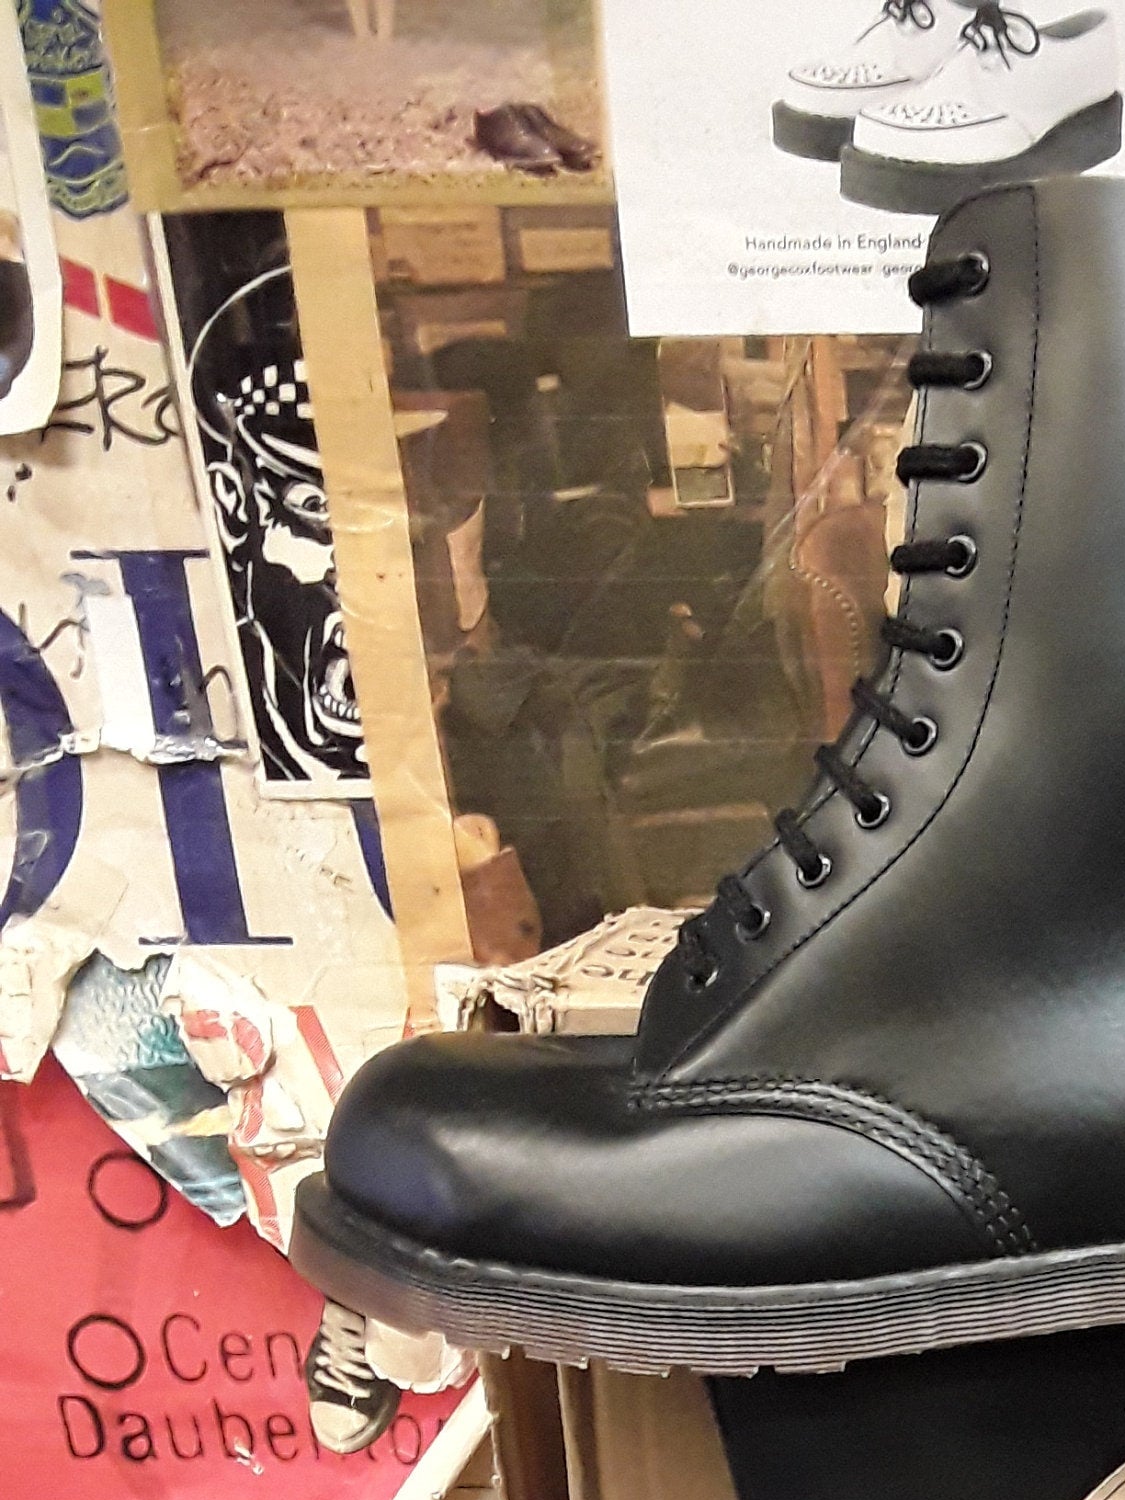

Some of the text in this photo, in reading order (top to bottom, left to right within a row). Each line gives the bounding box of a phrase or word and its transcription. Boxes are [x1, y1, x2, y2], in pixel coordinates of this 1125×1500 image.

[745, 232, 924, 254] Handmade in England
